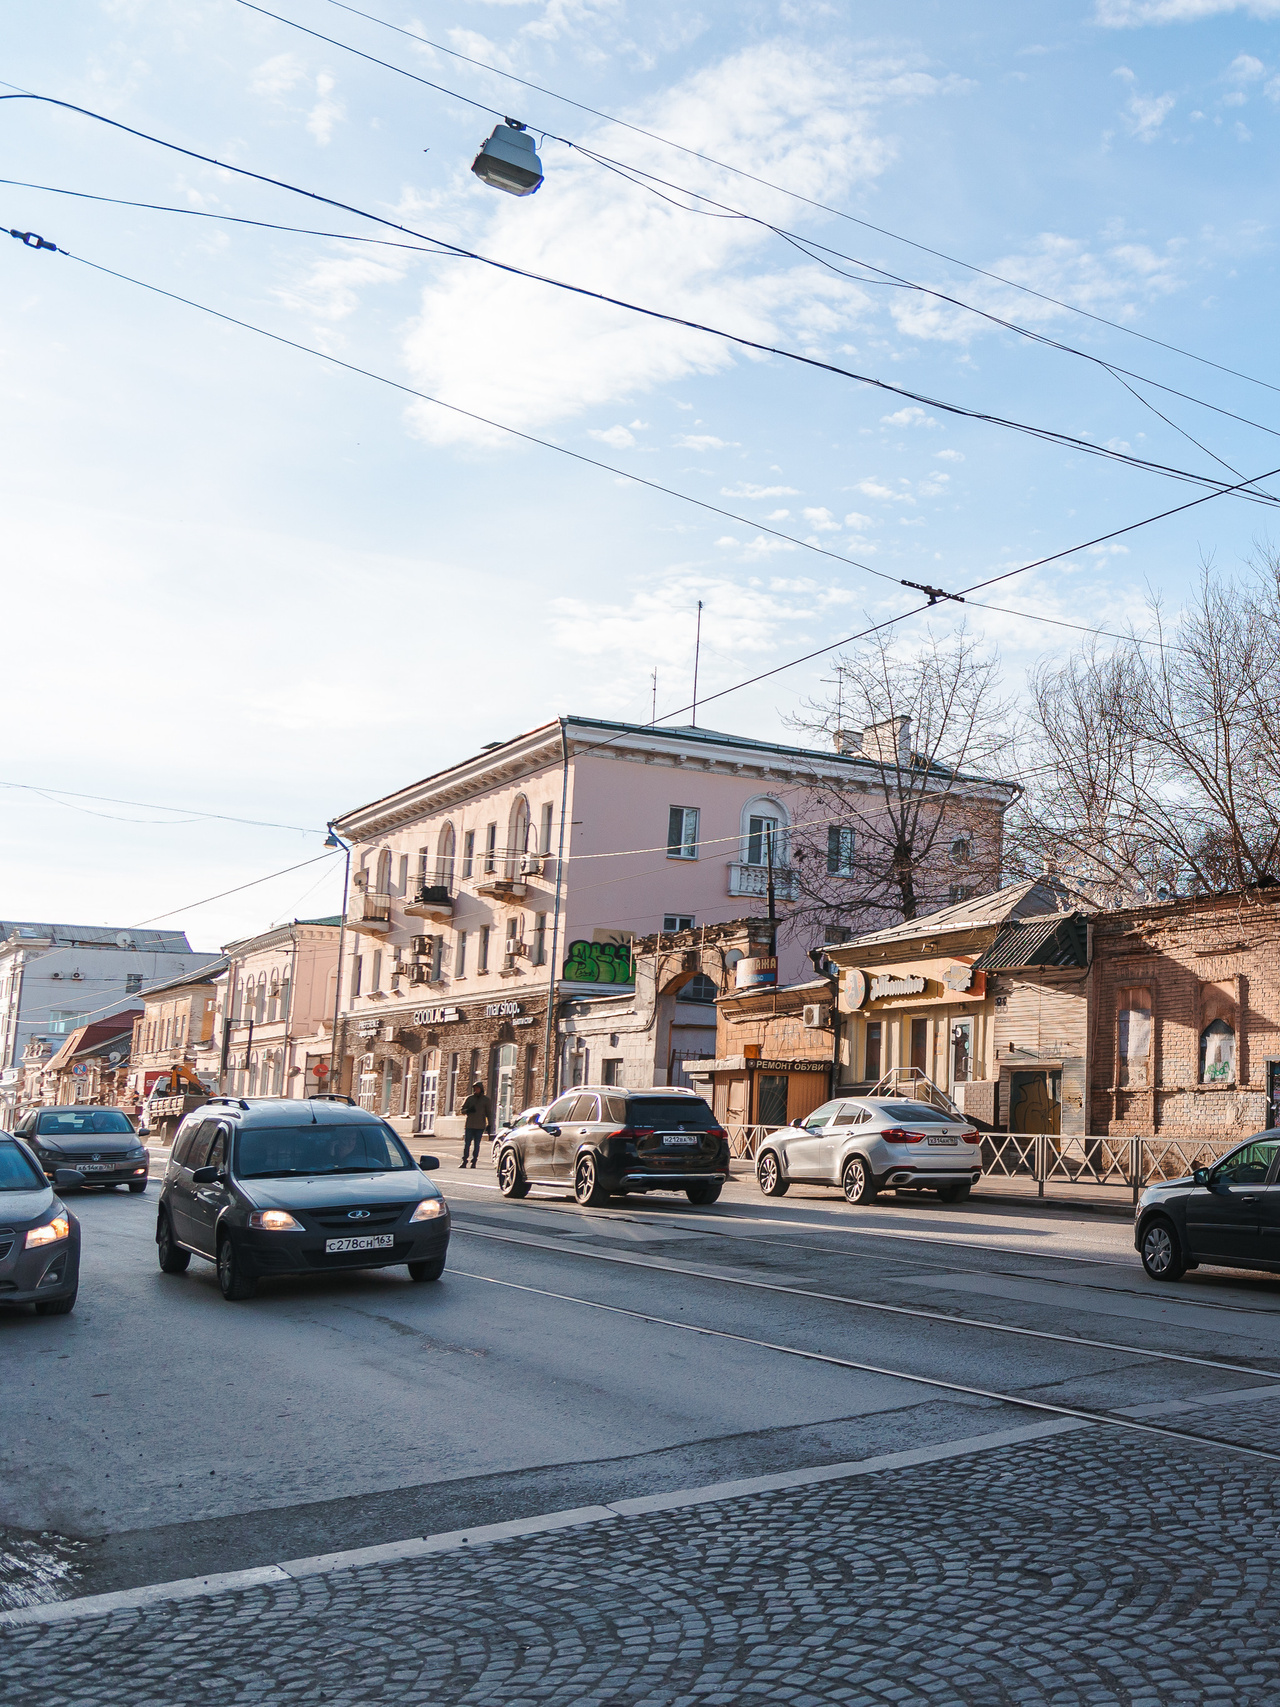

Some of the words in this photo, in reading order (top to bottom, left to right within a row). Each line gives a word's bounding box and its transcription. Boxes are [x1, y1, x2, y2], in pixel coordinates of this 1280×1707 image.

[414, 1008, 444, 1025] GOODLAC
[756, 1061, 792, 1070] РЕМОНТ
[794, 1062, 825, 1071] ОБУВИ
